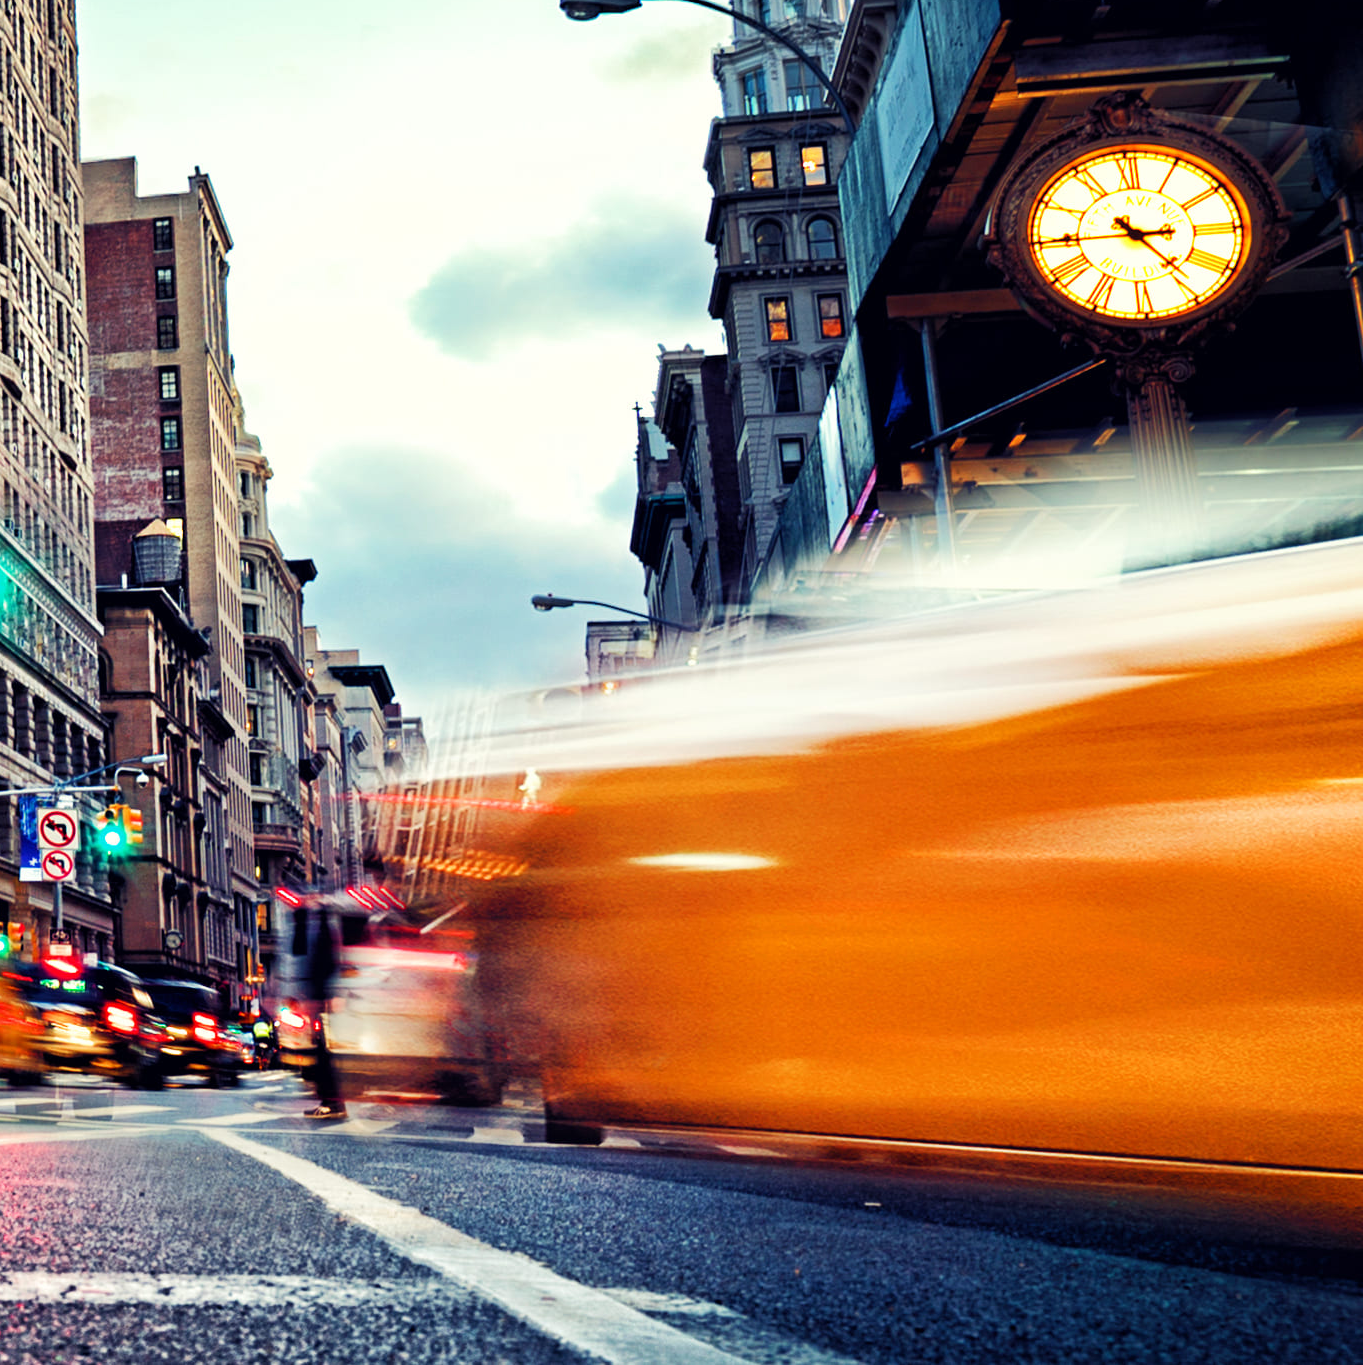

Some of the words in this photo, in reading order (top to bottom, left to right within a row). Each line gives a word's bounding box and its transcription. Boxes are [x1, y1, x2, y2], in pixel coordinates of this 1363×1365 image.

[1073, 167, 1108, 203] XI
[1115, 158, 1141, 191] XII
[1157, 163, 1178, 194] I
[1045, 199, 1086, 222] X
[1180, 185, 1217, 211] II
[1193, 221, 1235, 237] III
[1050, 252, 1093, 289] VIII
[1086, 273, 1116, 310] VII
[1134, 280, 1154, 314] VI
[1170, 272, 1199, 302] V
